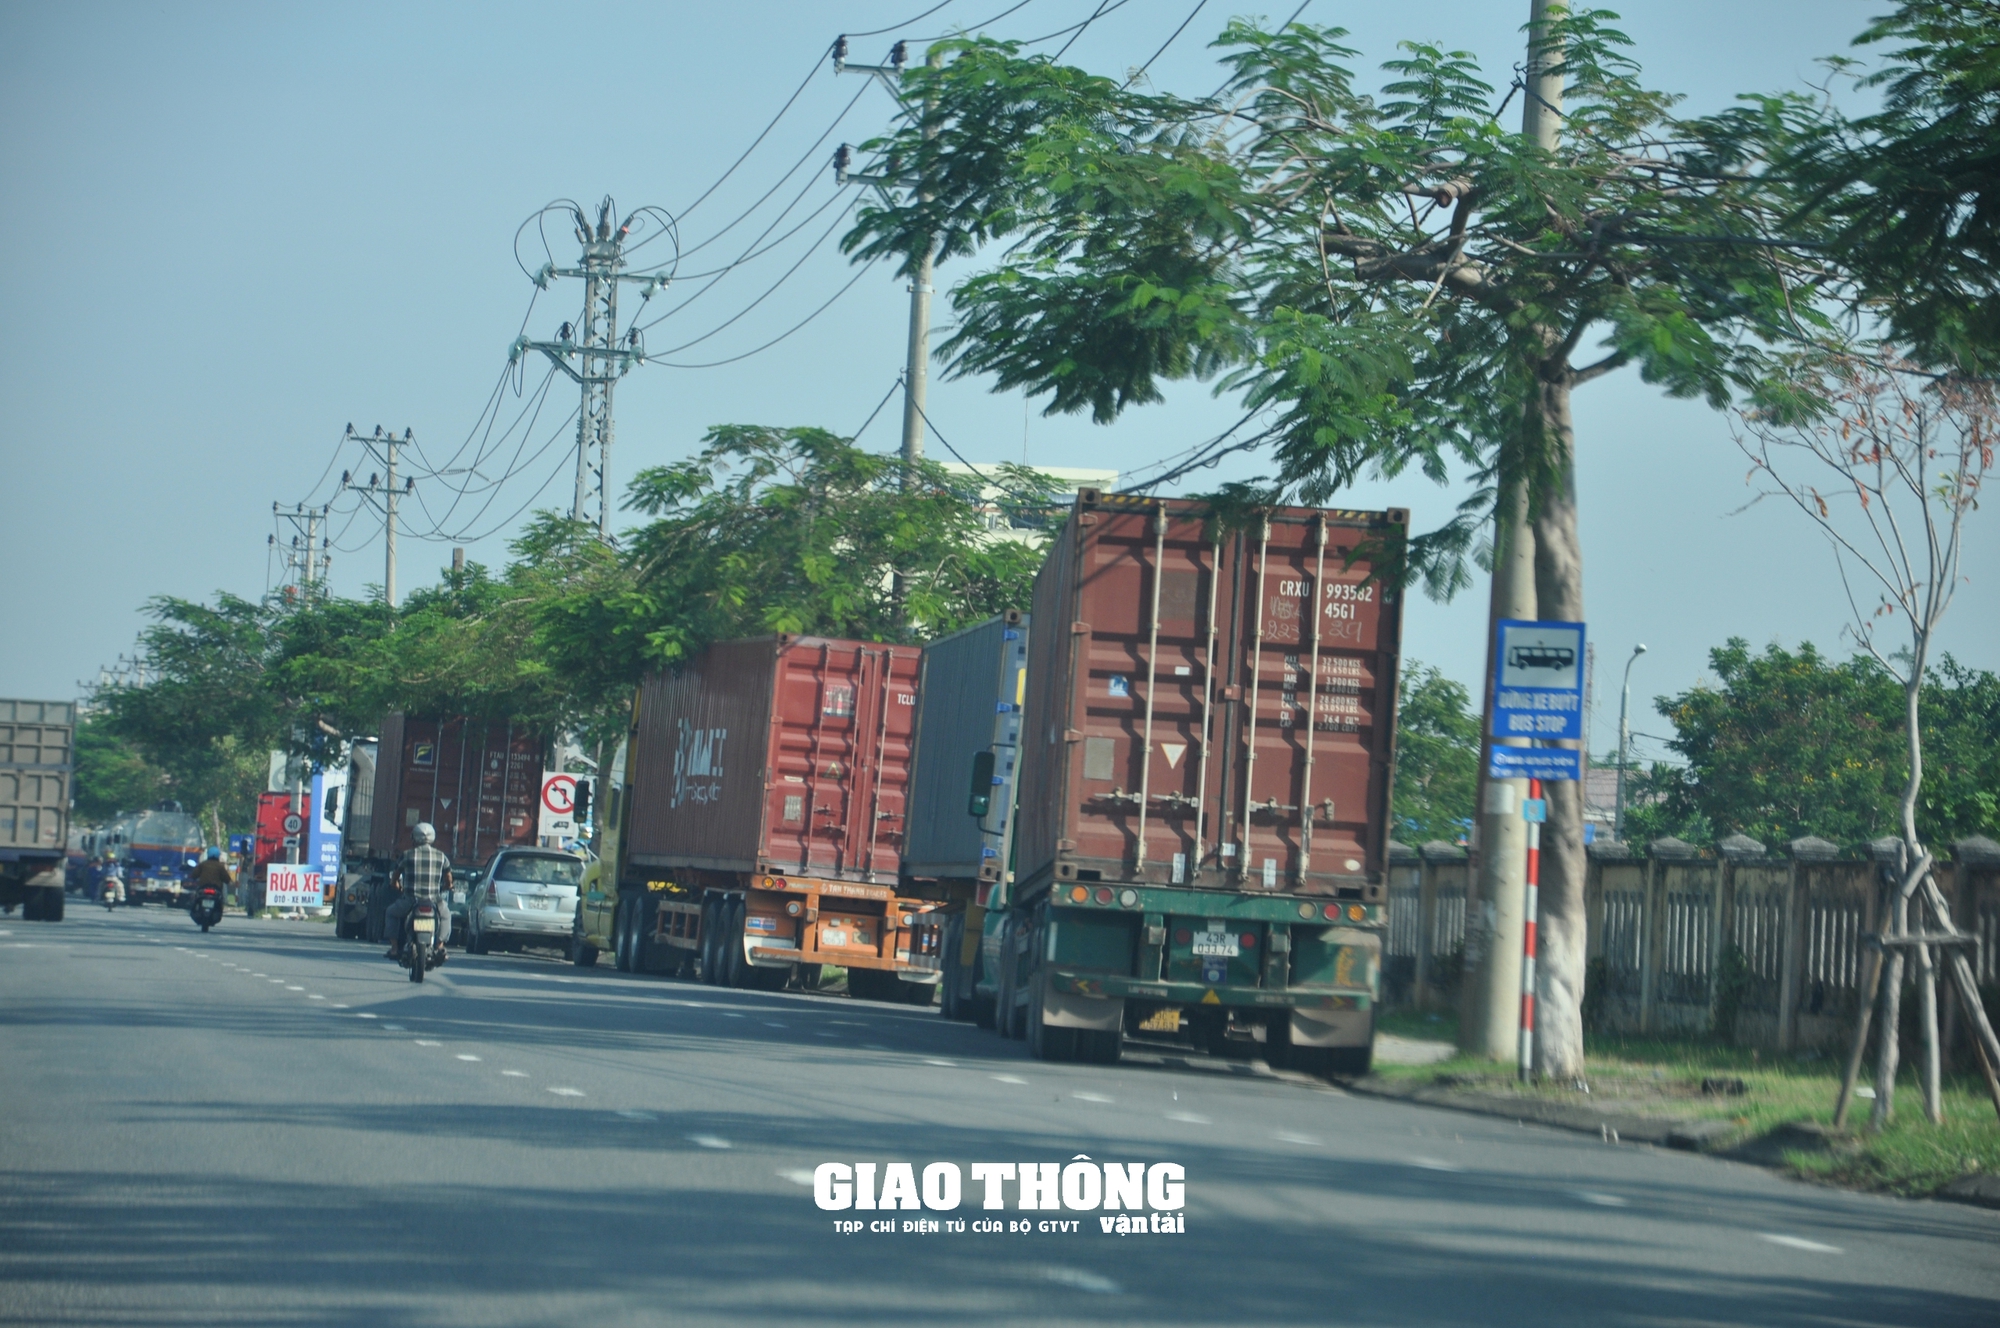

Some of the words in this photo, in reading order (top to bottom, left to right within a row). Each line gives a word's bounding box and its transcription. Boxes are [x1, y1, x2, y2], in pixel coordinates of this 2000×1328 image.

[1280, 580, 1309, 597] CRXU
[1326, 583, 1373, 602] 993582
[1325, 603, 1355, 620] 45G1
[897, 693, 916, 706] TCLU
[1508, 713, 1535, 732] BUS
[1535, 714, 1567, 733] STOP
[287, 819, 298, 830] 40
[270, 866, 298, 892] RỬA
[303, 873, 320, 892] XE
[291, 895, 299, 904] XE
[1206, 933, 1227, 944] 43R
[1197, 944, 1234, 955] 033.74
